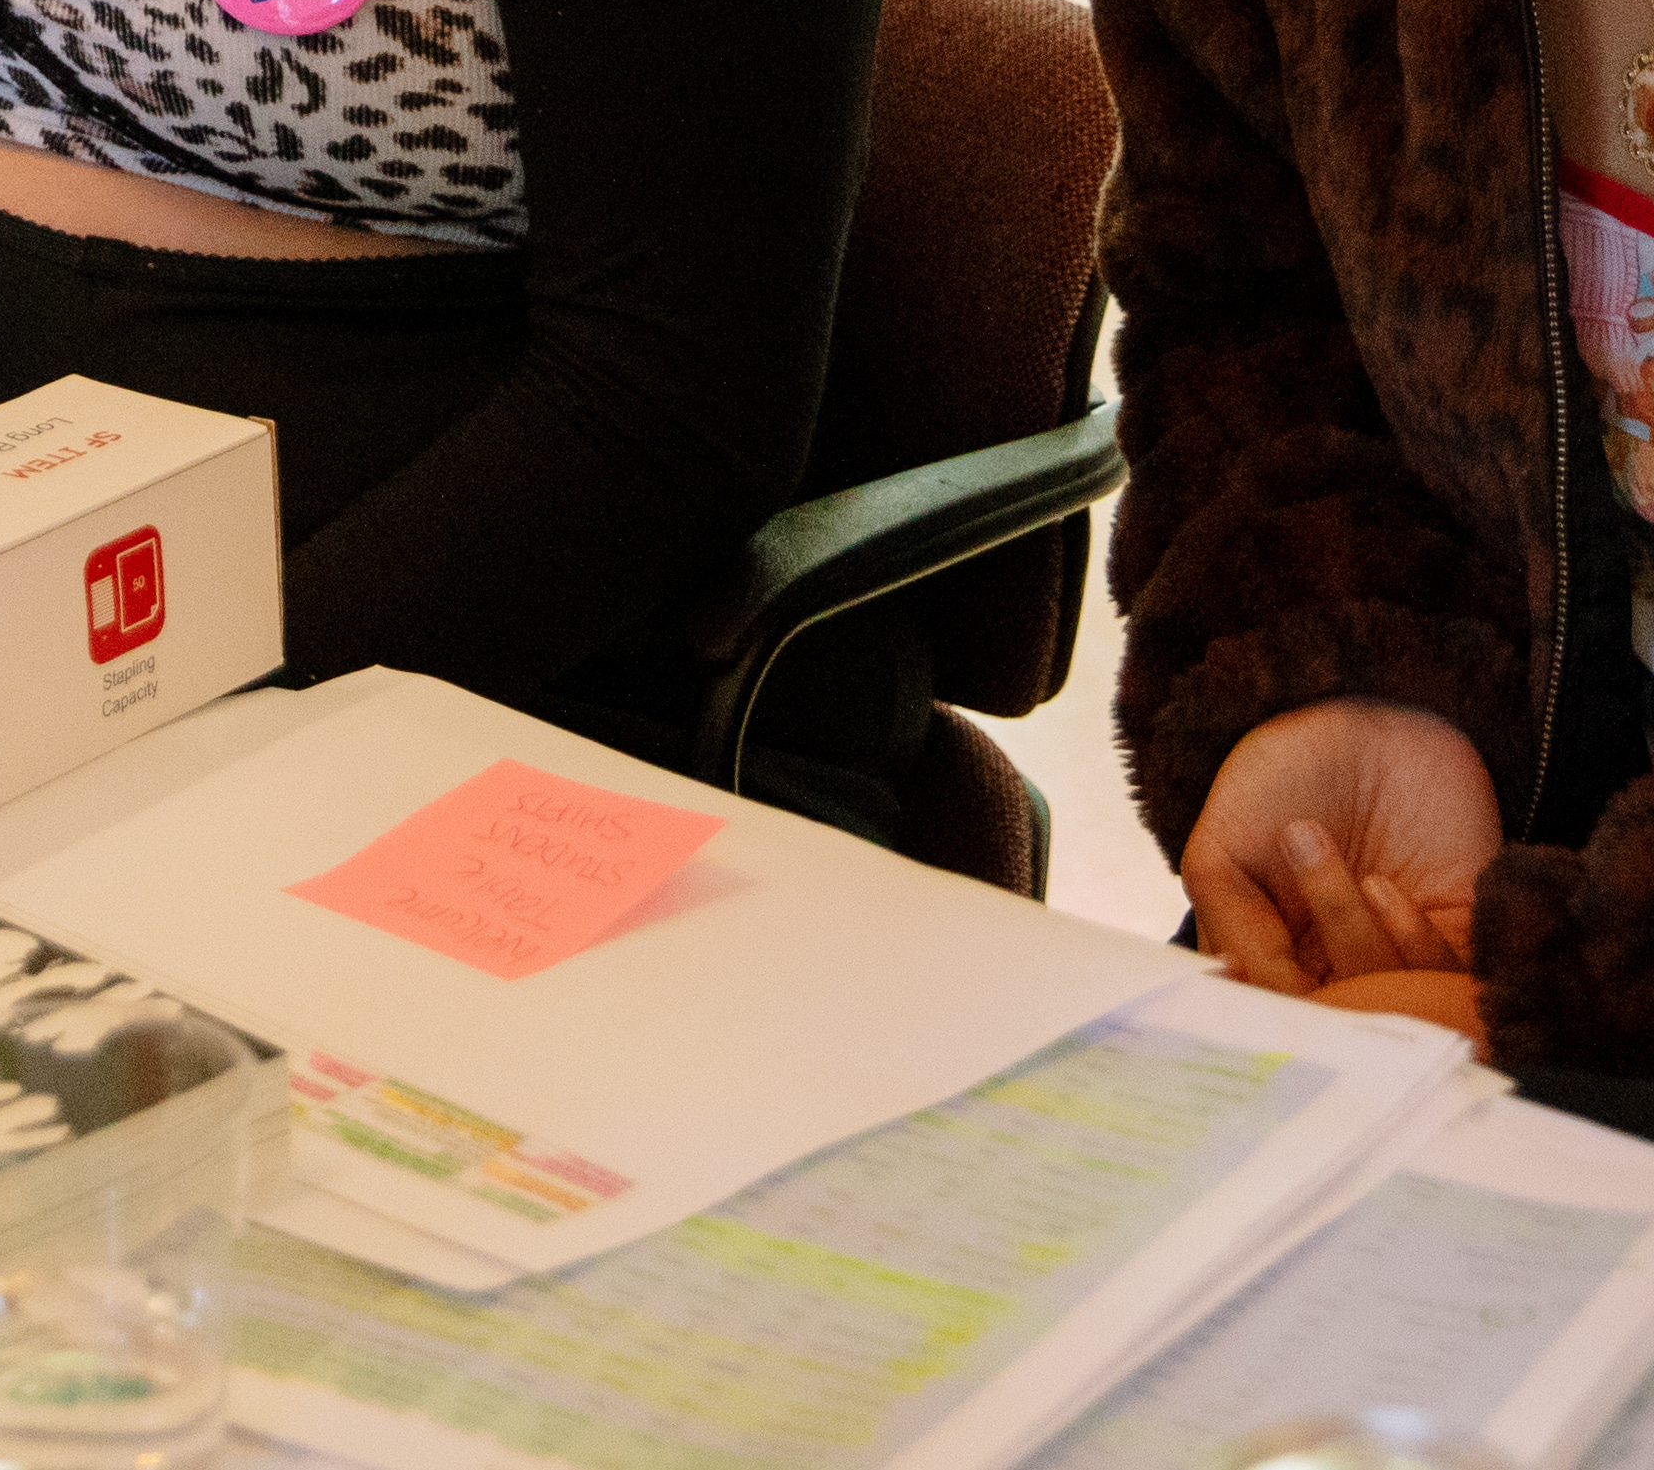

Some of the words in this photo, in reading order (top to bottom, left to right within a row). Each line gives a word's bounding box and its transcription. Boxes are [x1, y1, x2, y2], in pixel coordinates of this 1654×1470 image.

[5, 415, 74, 443] Long
[0, 447, 88, 481] ITEM
[103, 655, 156, 692] Stapling
[102, 680, 159, 718] Capacity
